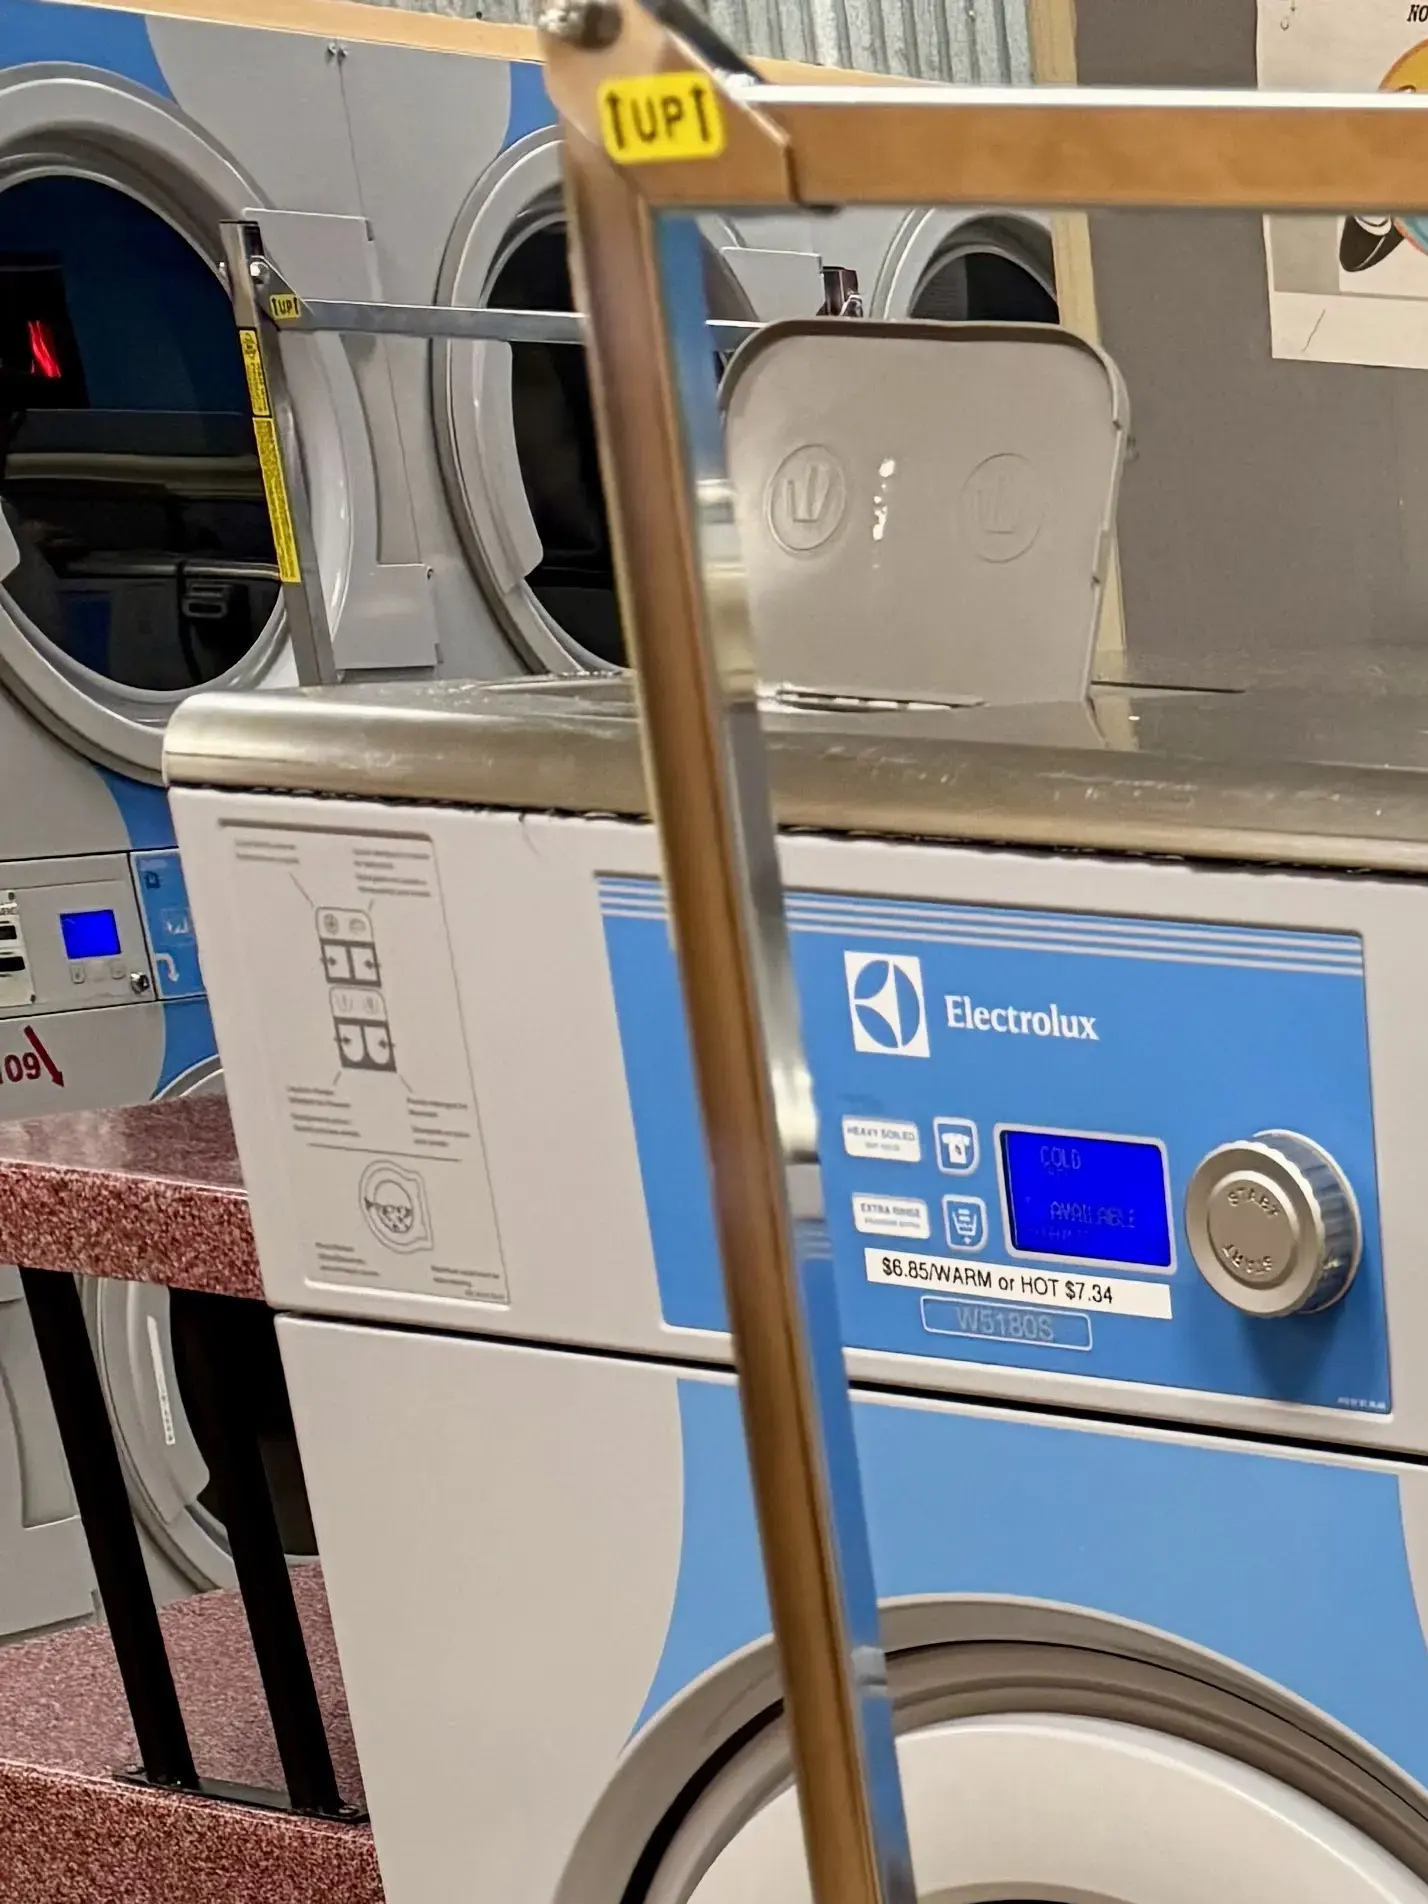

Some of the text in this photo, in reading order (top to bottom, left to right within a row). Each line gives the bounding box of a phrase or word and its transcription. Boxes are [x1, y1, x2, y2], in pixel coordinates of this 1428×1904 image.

[1407, 4, 1428, 22] NO
[630, 96, 684, 144] UP
[278, 299, 294, 315] UP
[944, 994, 1099, 1040] Electrolux
[0, 1053, 41, 1084] 09
[1040, 1146, 1081, 1169] COLD
[860, 1203, 890, 1215] EXTRA
[882, 1257, 1113, 1304] $6.85/WARM or HOT $7.34
[956, 1306, 1054, 1342] W5180S
